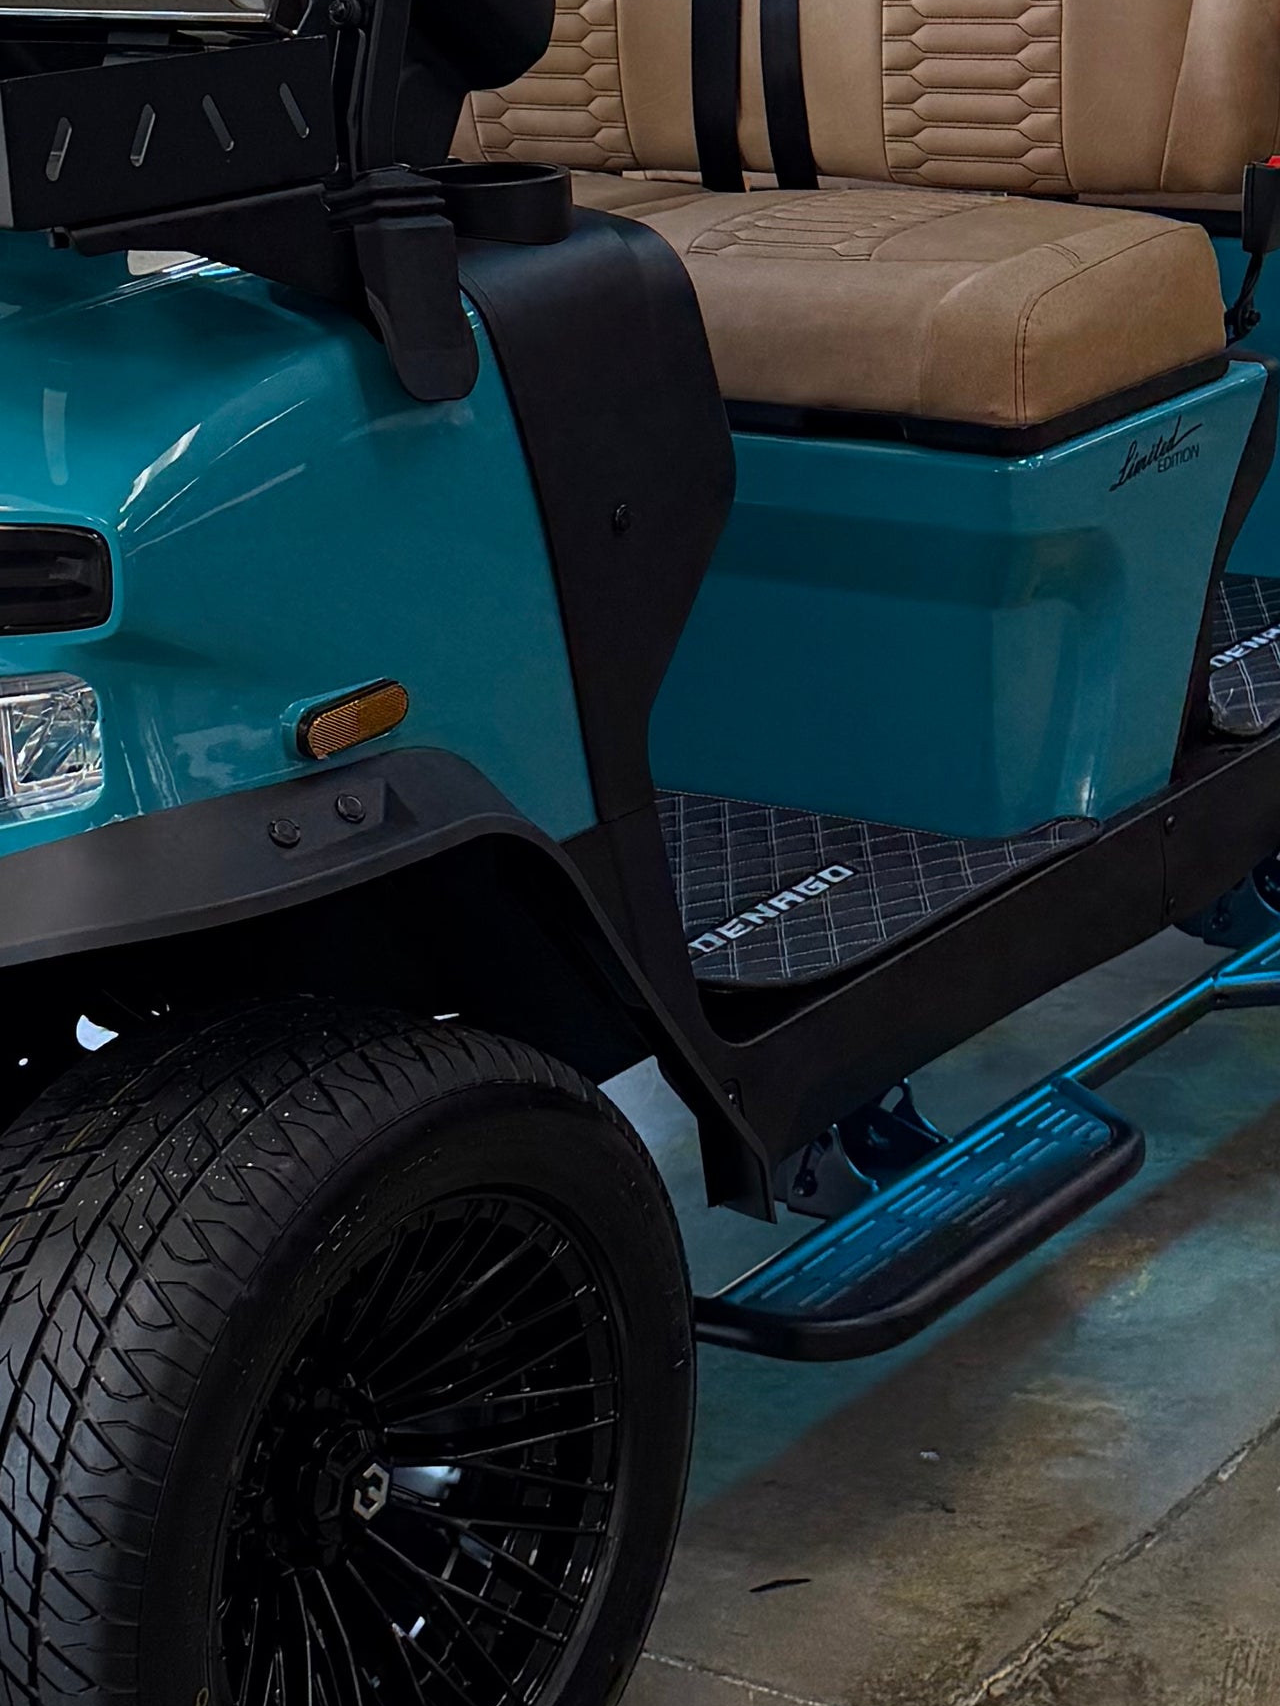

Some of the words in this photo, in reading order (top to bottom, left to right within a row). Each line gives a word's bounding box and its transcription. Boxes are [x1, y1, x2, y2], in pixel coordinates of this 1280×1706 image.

[1108, 414, 1203, 492] Limited
[1157, 443, 1200, 473] EDITION
[687, 864, 854, 953] DENAGO
